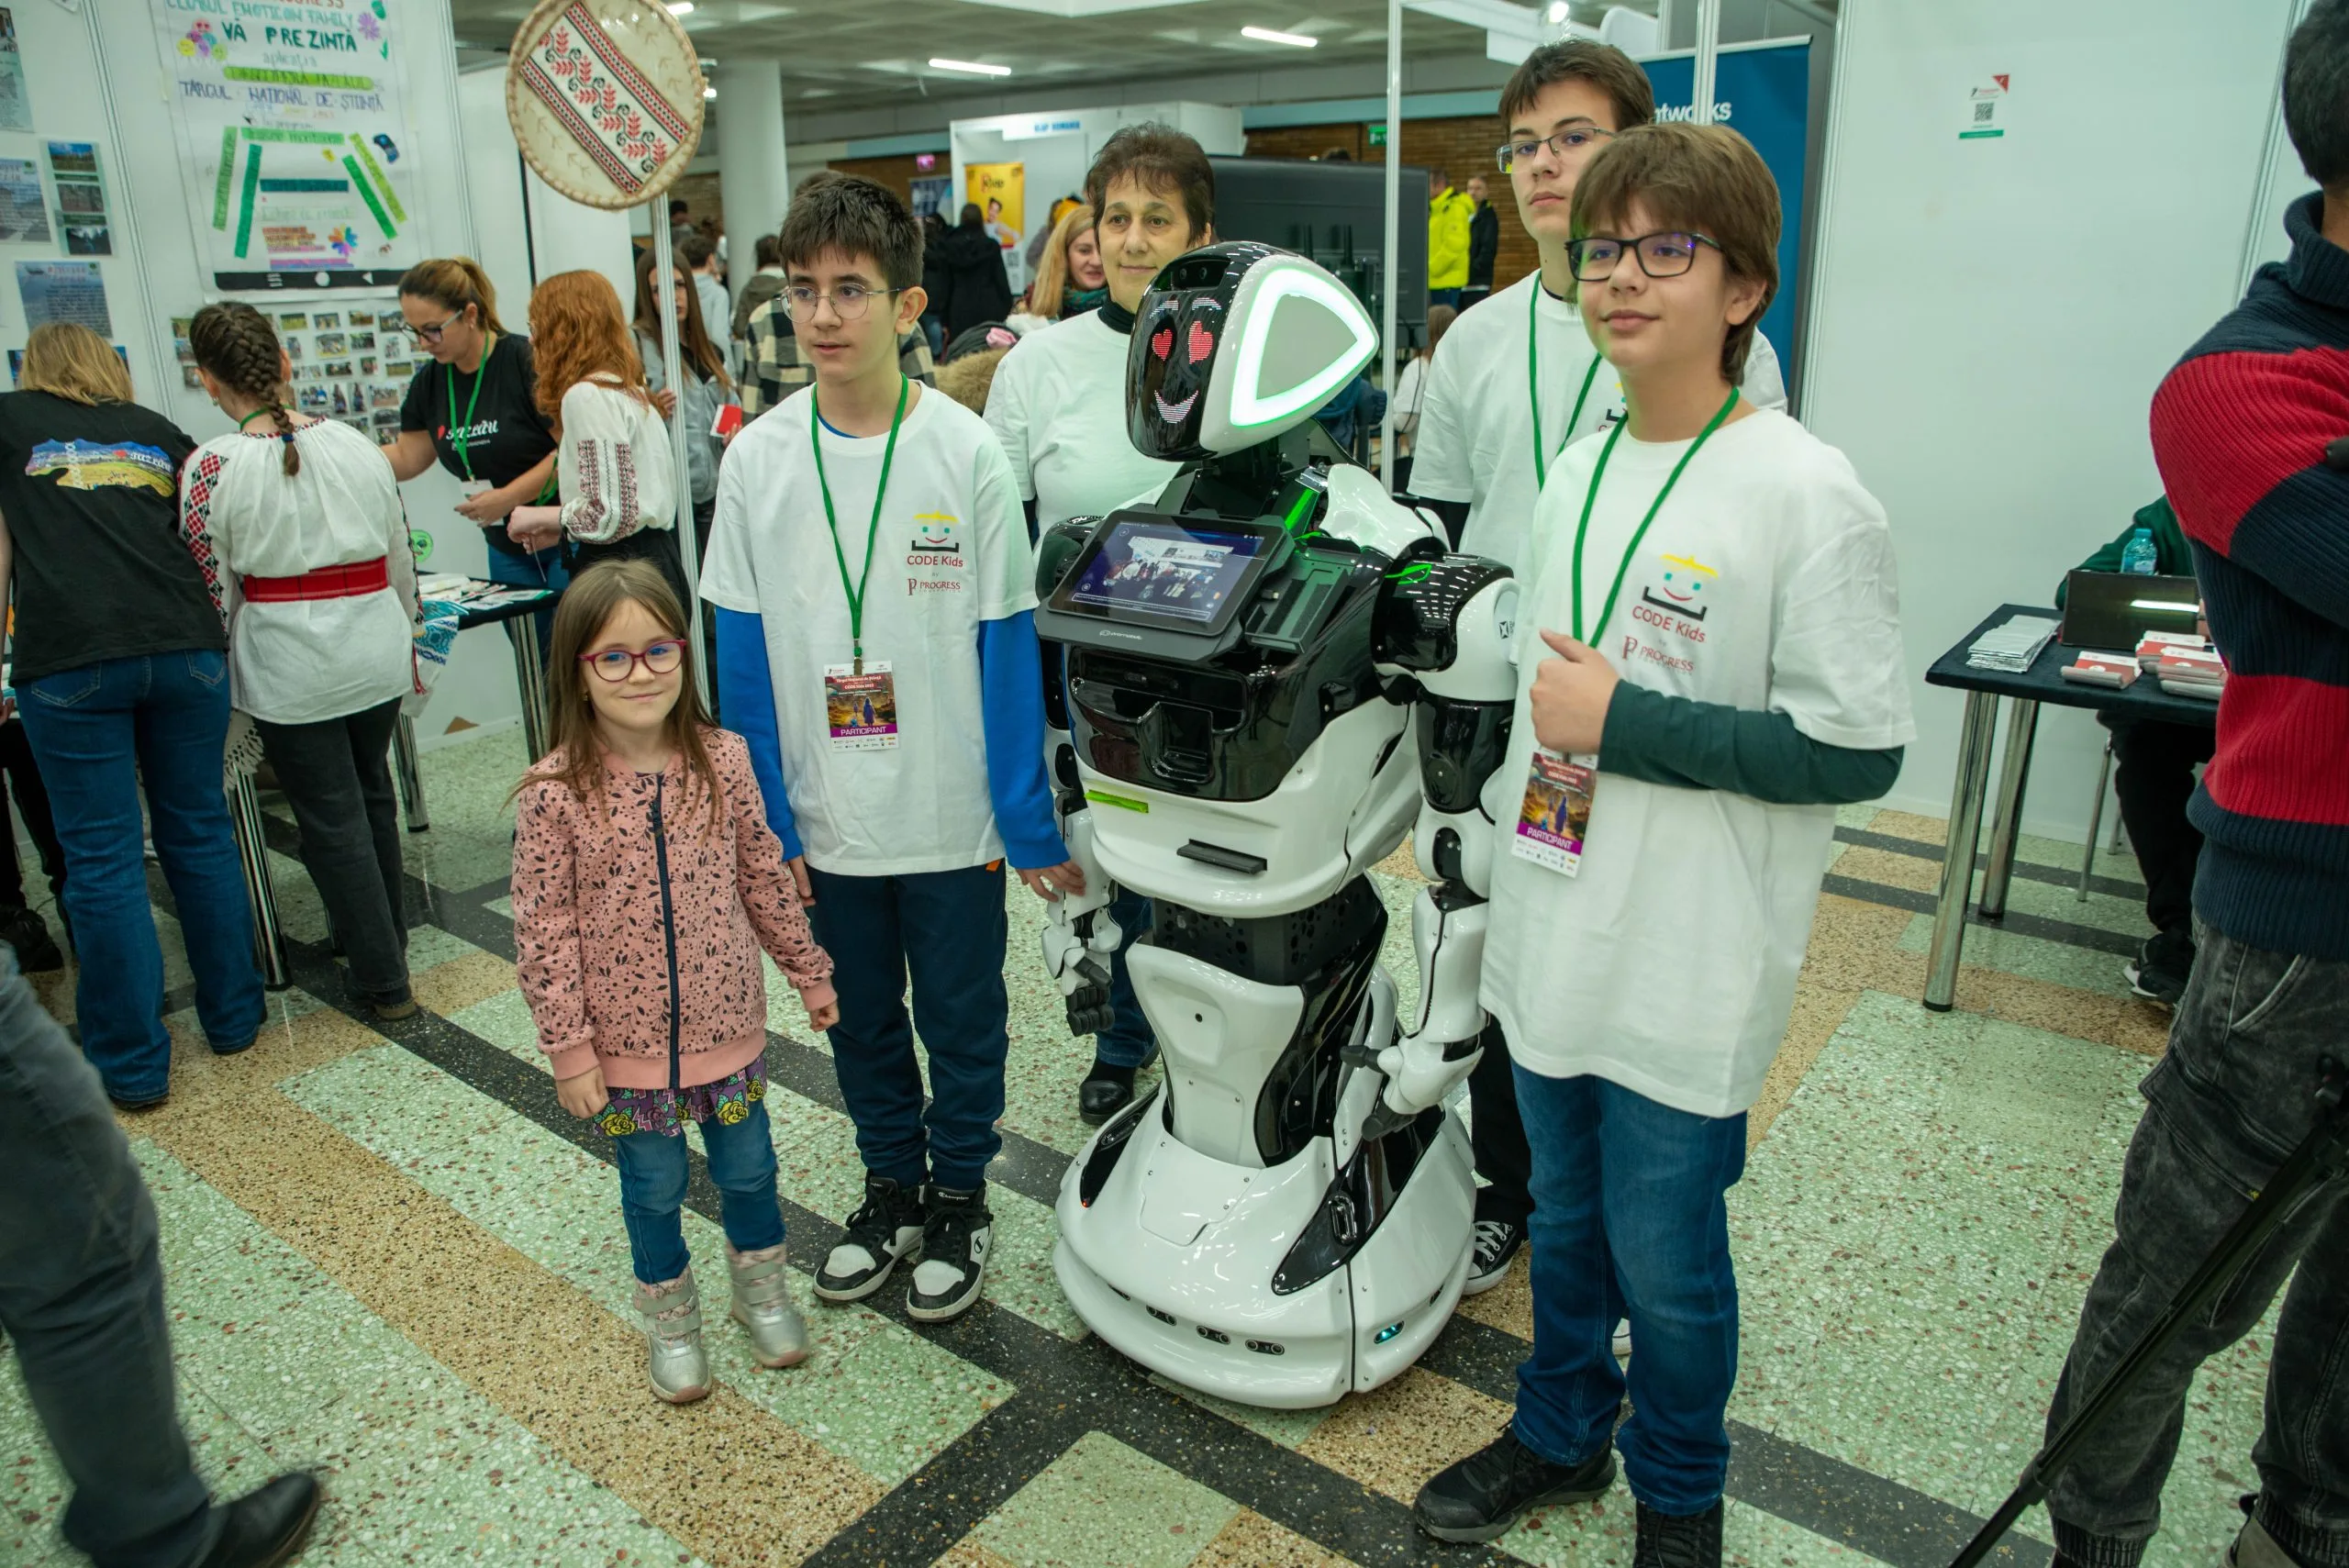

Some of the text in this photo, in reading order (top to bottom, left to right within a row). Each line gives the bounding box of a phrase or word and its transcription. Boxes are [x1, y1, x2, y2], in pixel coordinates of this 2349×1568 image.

[231, 2, 303, 23] EMOTICON
[220, 17, 358, 52] VĂ PREZINTĂ
[315, 92, 333, 108] DE
[907, 555, 963, 568] CODE Kids
[919, 581, 961, 590] PROGRESS
[1632, 605, 1707, 643] CODE Kids
[1638, 646, 1696, 673] PROGRESS
[841, 726, 887, 736] PARTICIPANT
[1526, 827, 1574, 850] PARTICIPANT
